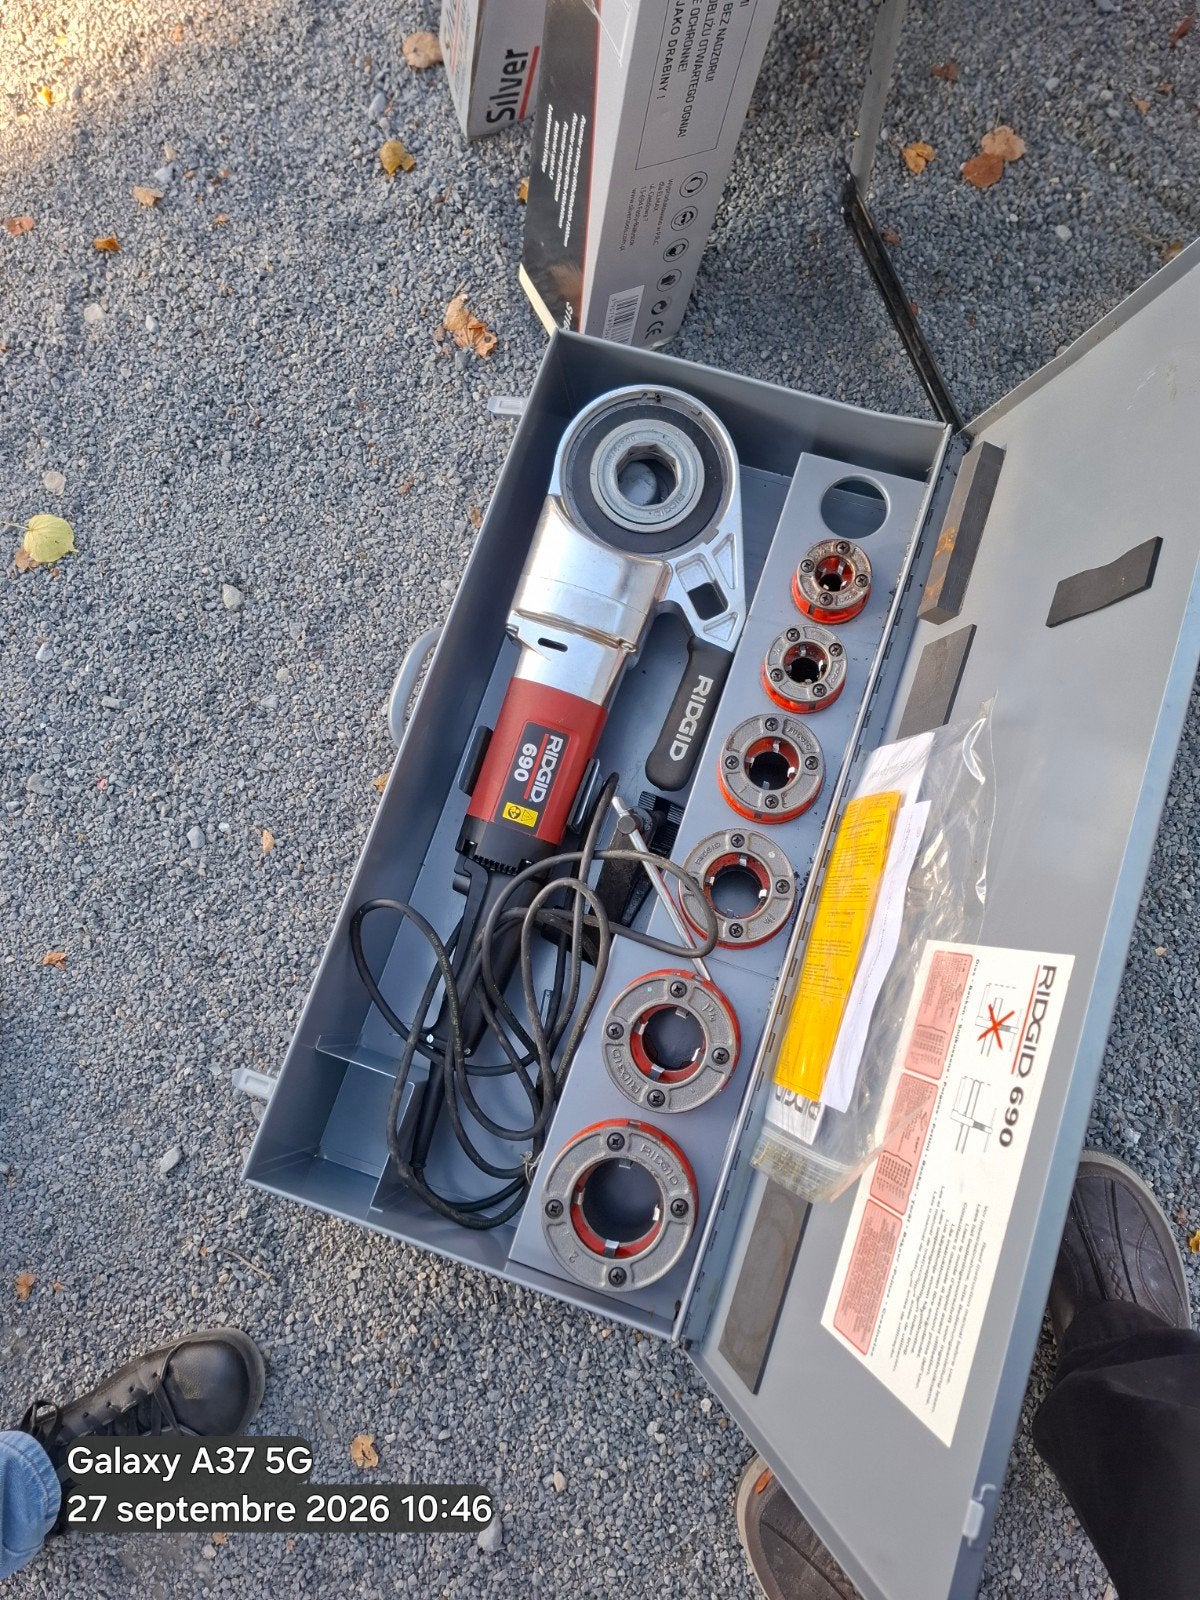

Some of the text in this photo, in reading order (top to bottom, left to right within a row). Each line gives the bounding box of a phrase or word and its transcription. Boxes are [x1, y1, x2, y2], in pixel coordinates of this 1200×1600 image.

[670, 0, 685, 35] JAKO
[678, 8, 700, 72] OCHRONNE!
[705, 2, 734, 82] BEZ NADZORU!
[486, 49, 528, 123] Silver
[658, 40, 678, 92] DRABINY
[686, 39, 708, 103] OTWARTEGO
[678, 105, 692, 138] OGNIA!
[670, 675, 714, 762] RIDGID
[514, 742, 538, 782] 690
[530, 735, 564, 803] RIDGID
[998, 965, 1057, 1149] RIDGID 690
